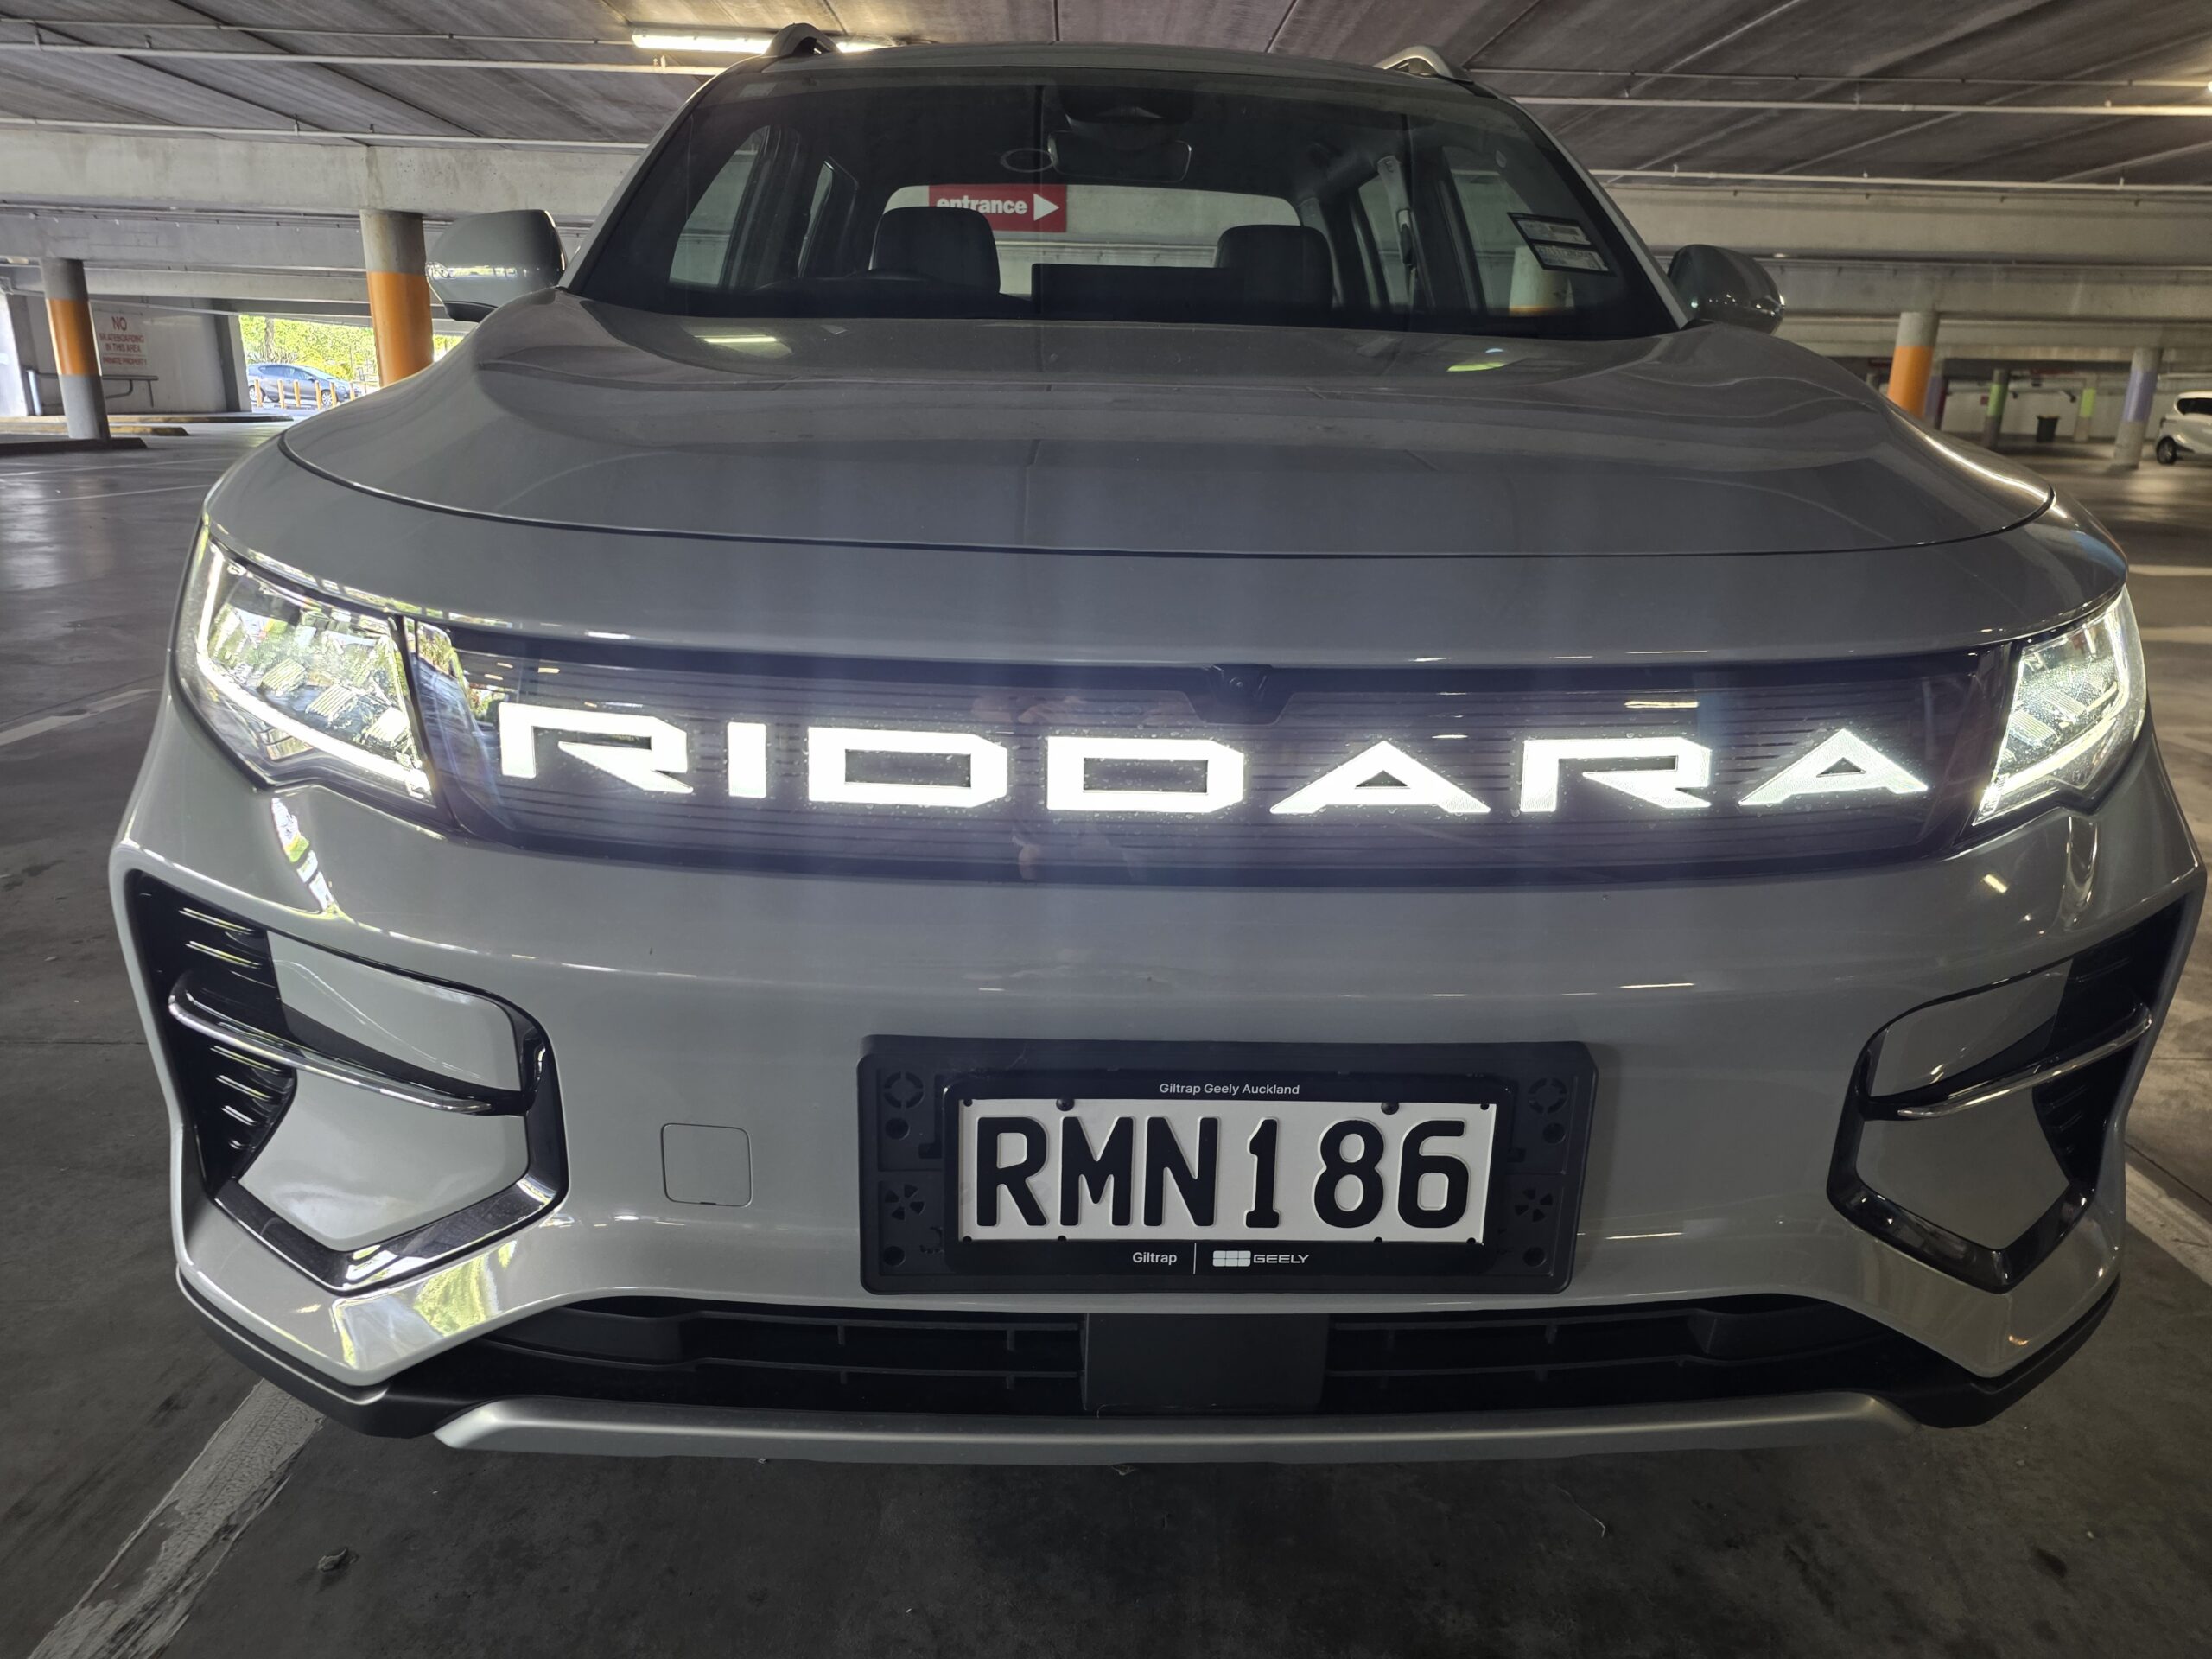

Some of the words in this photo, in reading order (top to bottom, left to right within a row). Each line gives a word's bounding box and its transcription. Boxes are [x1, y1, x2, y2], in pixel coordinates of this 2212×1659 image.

[937, 195, 1027, 214] entrance
[111, 315, 128, 331] NO
[499, 702, 1929, 817] RIDDARA
[1159, 1083, 1201, 1096] Giltrap
[1204, 1083, 1239, 1096] Geely
[1242, 1084, 1300, 1095] Auckland
[976, 1117, 1469, 1229] RMN186
[1132, 1251, 1178, 1266] Giltrap
[1253, 1254, 1310, 1264] GEELY
